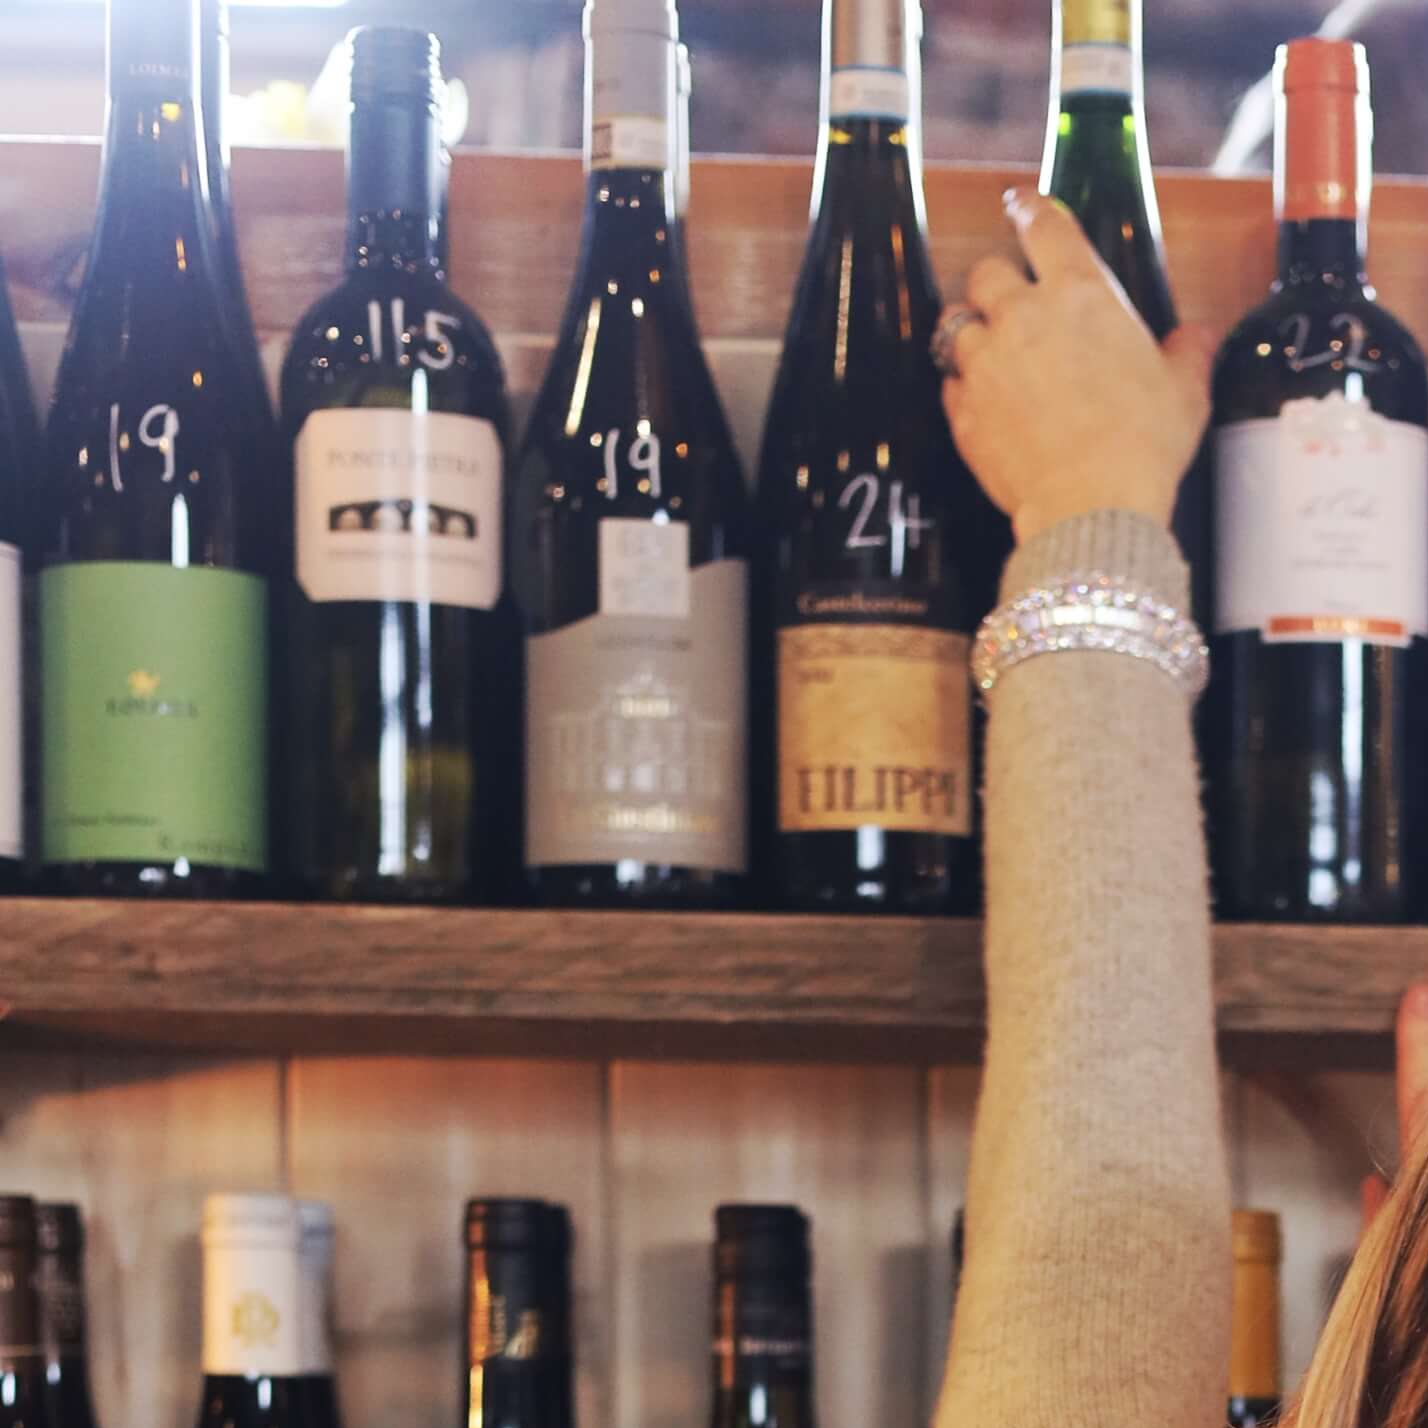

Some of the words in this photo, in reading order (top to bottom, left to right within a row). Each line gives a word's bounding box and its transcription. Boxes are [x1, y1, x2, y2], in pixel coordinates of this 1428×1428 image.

[1279, 313, 1382, 372] 22
[109, 402, 180, 492] 19
[603, 428, 662, 499] 19
[838, 473, 931, 550] 24
[798, 764, 957, 817] FILIPPI
